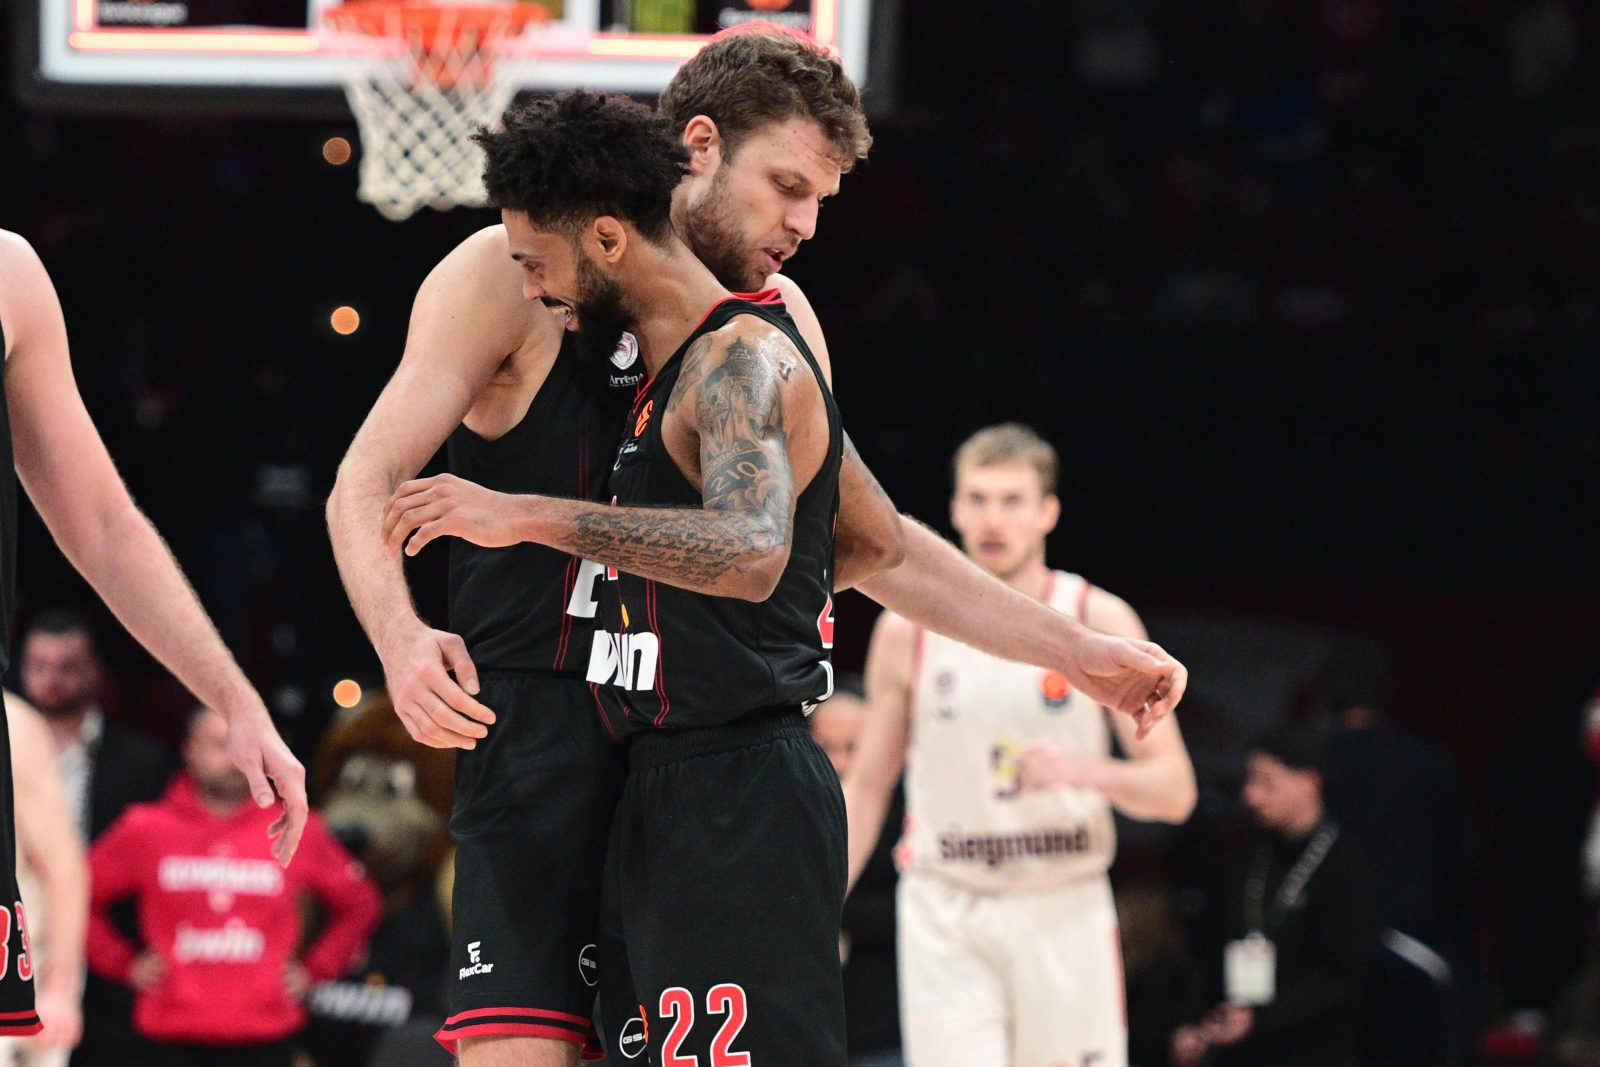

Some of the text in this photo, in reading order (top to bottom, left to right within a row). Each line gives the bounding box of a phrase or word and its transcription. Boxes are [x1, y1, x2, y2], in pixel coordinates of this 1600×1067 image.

[710, 461, 759, 492] 210
[459, 963, 494, 980] FlexCar
[659, 983, 751, 1067] 22
[622, 1033, 645, 1044] GS
